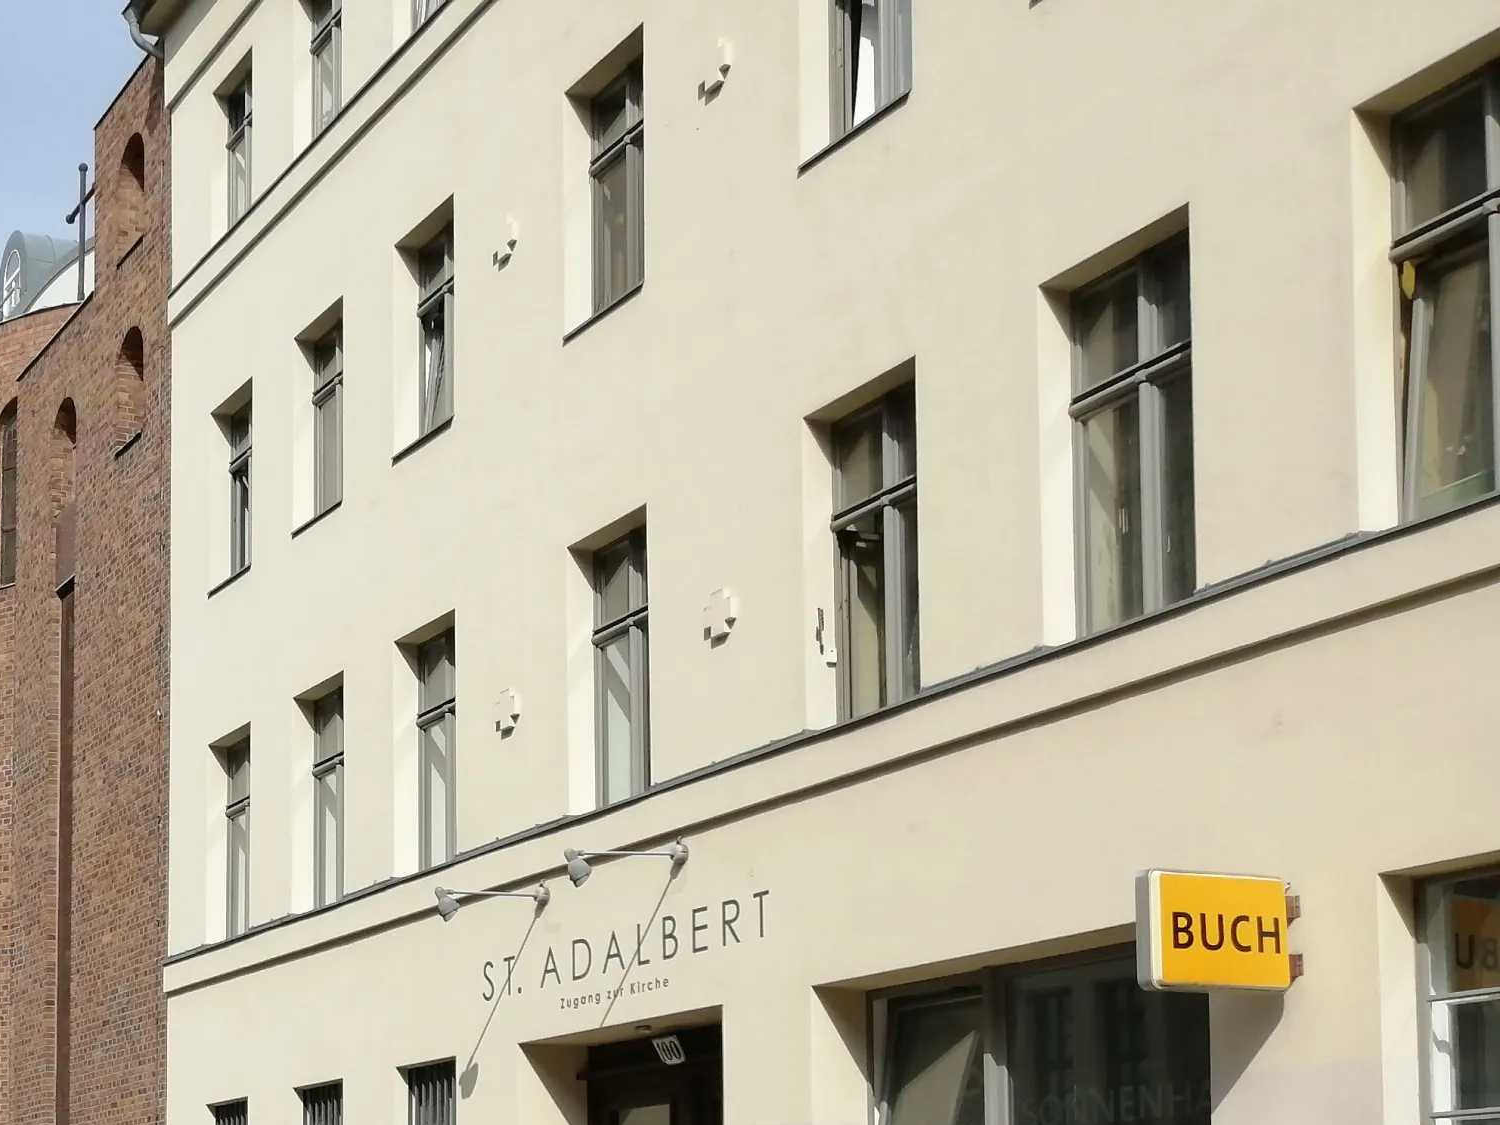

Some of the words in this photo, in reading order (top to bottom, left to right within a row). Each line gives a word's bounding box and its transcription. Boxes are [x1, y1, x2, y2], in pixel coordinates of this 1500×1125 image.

[482, 955, 523, 1001] ST.
[540, 890, 770, 988] ADALBERT
[1171, 911, 1282, 954] BUCH
[560, 990, 601, 1009] Zugang
[606, 987, 624, 1003] zur
[629, 976, 670, 995] Kirche
[656, 1037, 682, 1060] 100
